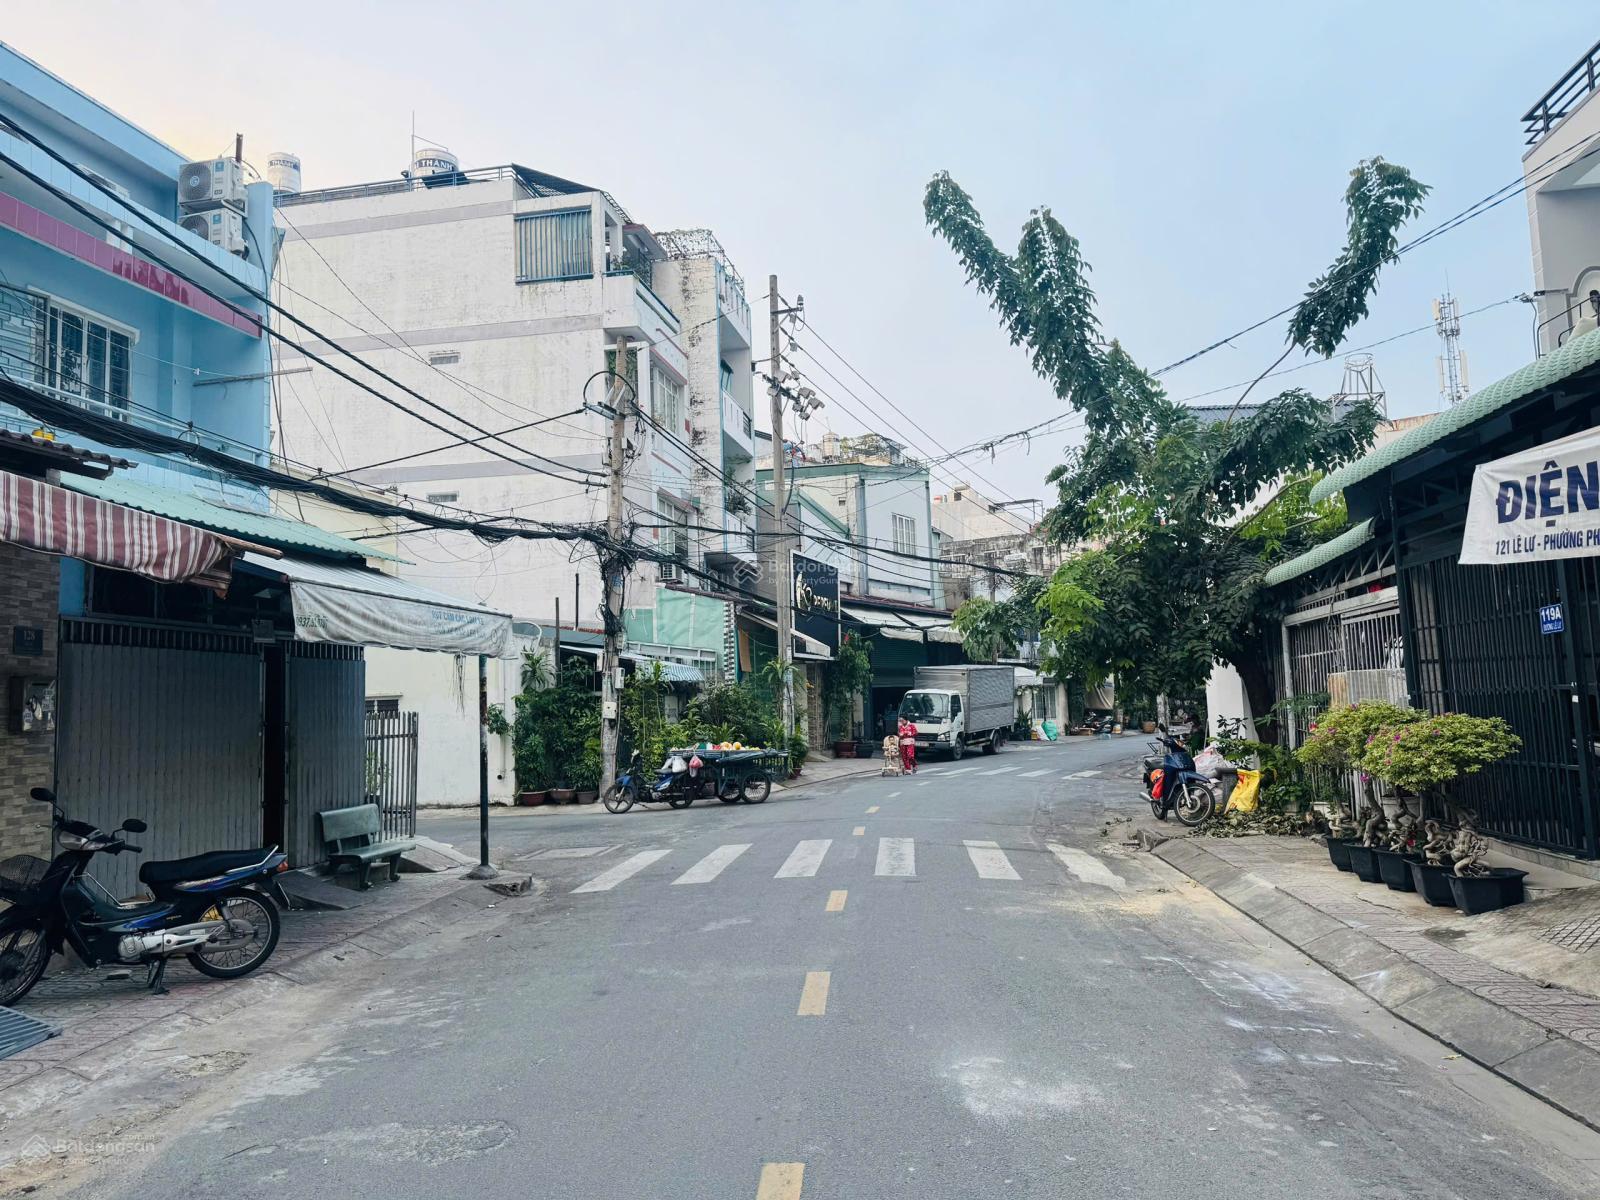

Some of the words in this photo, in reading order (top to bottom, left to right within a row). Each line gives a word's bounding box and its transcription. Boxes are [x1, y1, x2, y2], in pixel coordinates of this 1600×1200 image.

[1496, 460, 1600, 527] ĐIỆN
[1496, 539, 1510, 555] 121
[1513, 535, 1522, 554] LÊ
[1524, 534, 1537, 552] LƯ
[1543, 528, 1583, 551] PHƯỜNG
[1541, 606, 1561, 622] 119A
[24, 630, 36, 641] 128
